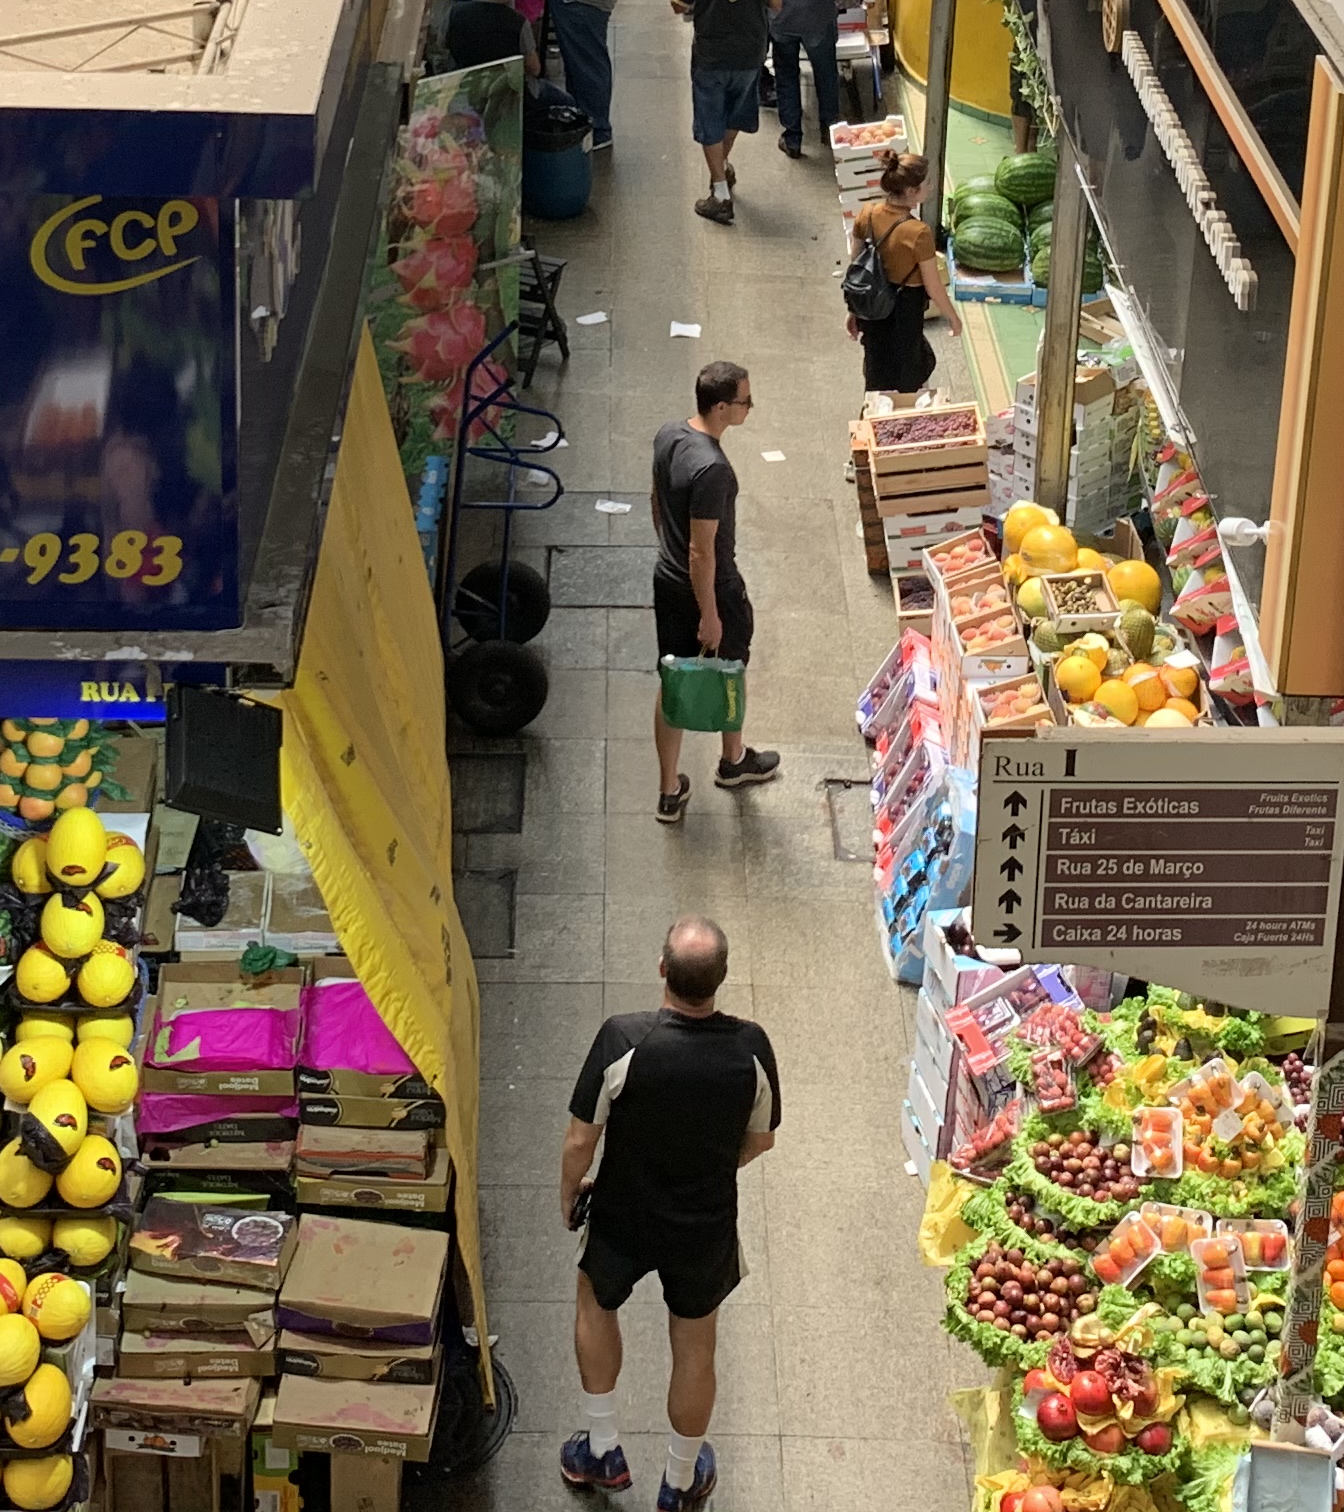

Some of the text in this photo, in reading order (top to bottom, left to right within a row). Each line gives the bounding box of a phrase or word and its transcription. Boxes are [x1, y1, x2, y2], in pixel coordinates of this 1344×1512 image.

[65, 200, 198, 270] FCP
[81, 681, 139, 702] RUA
[994, 749, 1078, 778] Rua I
[1061, 796, 1200, 815] Frutas Exóticas
[1260, 792, 1329, 804] Fruits Exotics
[1248, 804, 1328, 816] Frutas Diferente
[1059, 828, 1096, 845] Táxi
[1304, 824, 1325, 835] Taxi
[1303, 836, 1324, 847] Taxi
[1056, 859, 1204, 879] Rua 25 de Março
[1054, 893, 1213, 910] Rua da Cantareira
[1052, 925, 1182, 942] Caixa 24 horas
[1245, 920, 1316, 931] 24 hours ATMs
[1233, 932, 1314, 943] Caja Fuerte 24Hs
